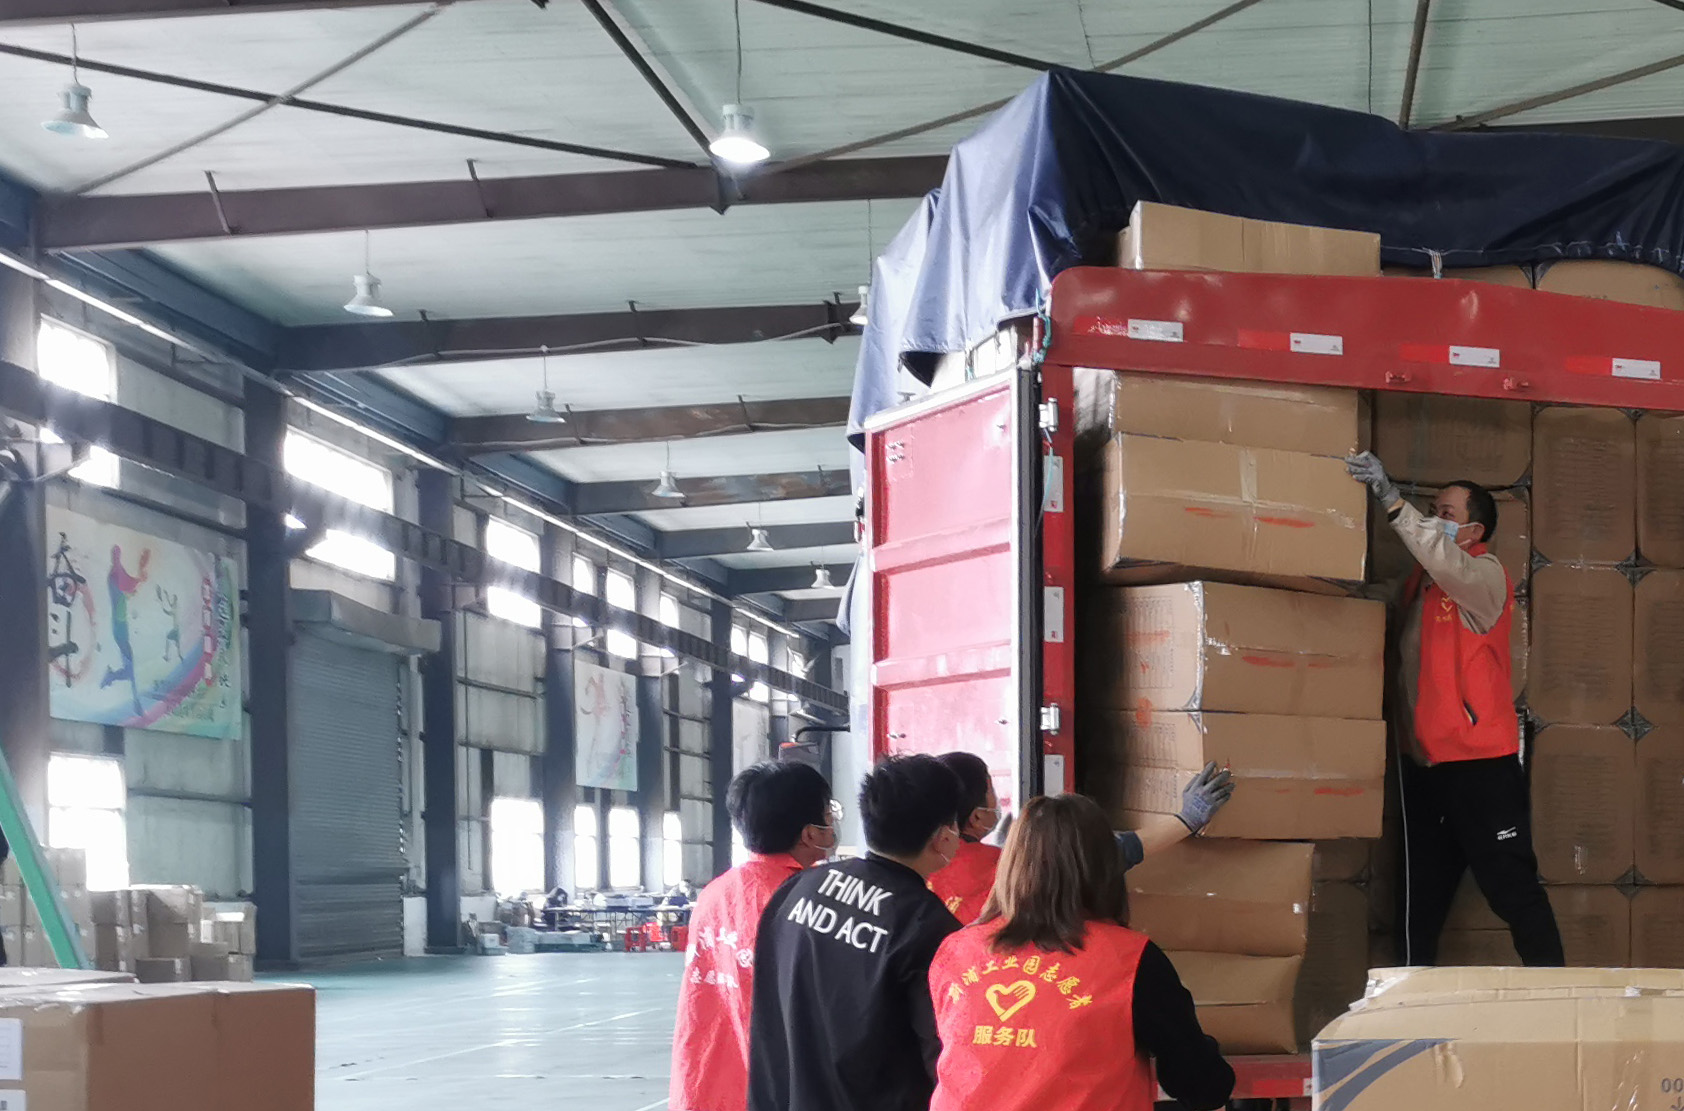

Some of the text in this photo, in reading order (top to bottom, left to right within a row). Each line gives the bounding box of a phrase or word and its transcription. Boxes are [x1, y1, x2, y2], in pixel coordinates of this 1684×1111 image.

[817, 868, 894, 917] THINK
[787, 897, 888, 953] AND ACT
[947, 955, 1094, 1011] 新浦工业园志愿者
[972, 1024, 1038, 1049] 服务队
